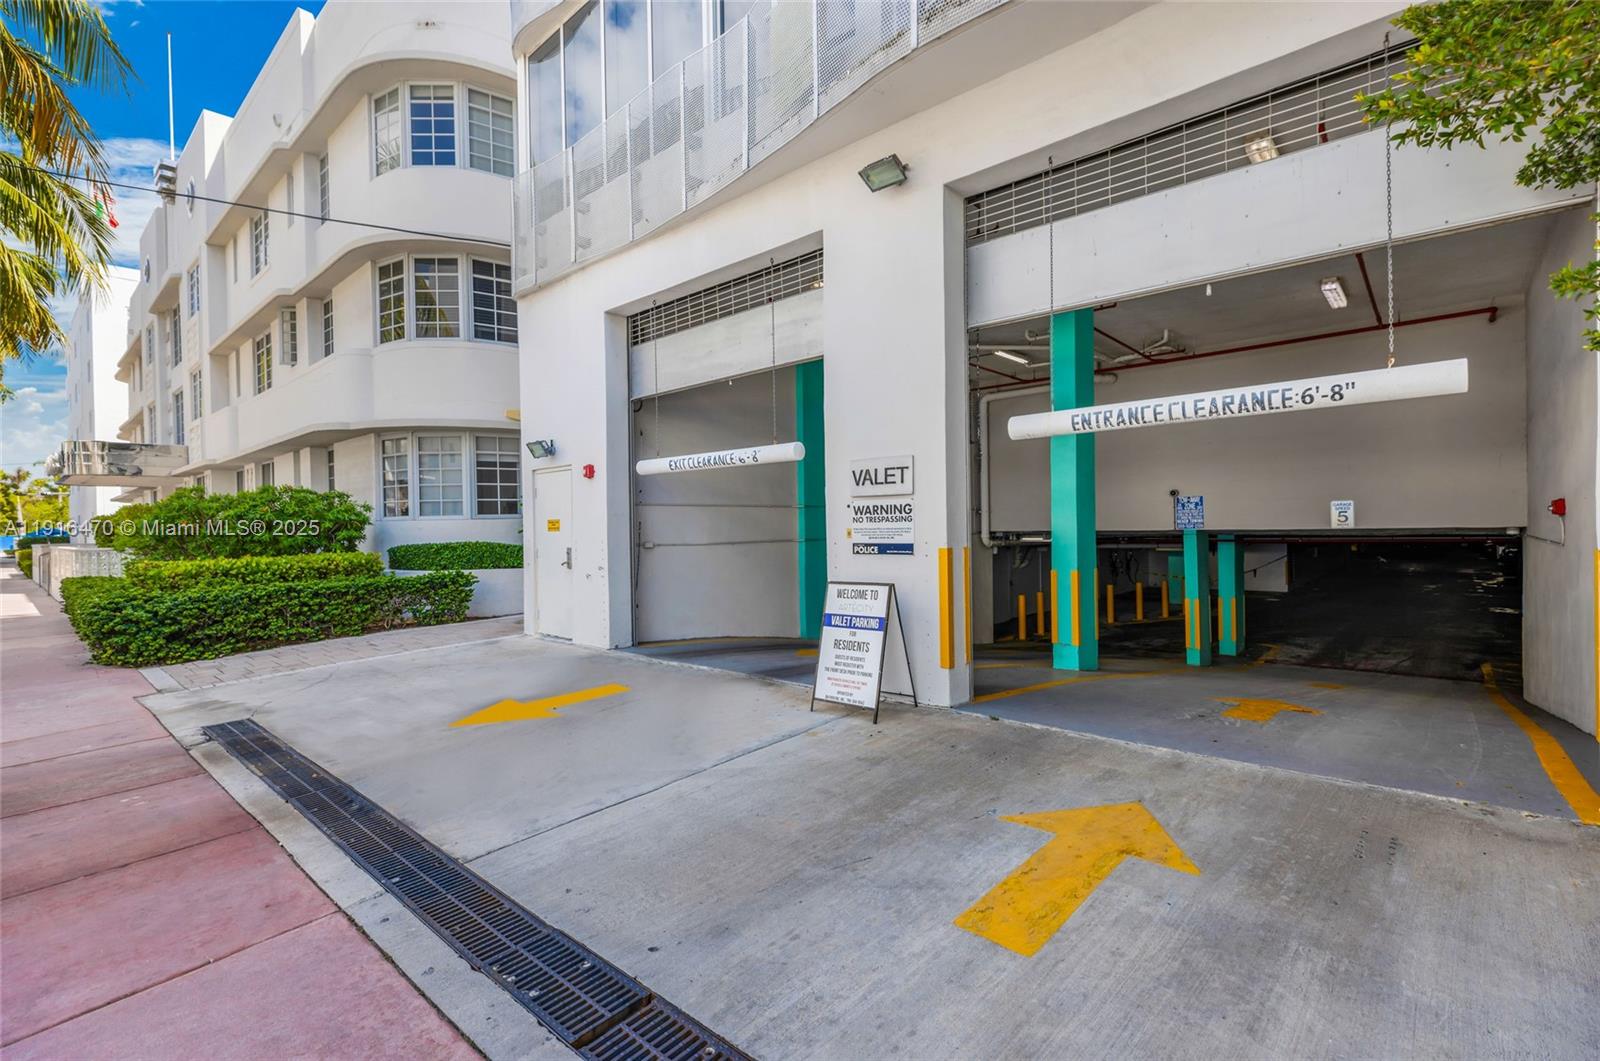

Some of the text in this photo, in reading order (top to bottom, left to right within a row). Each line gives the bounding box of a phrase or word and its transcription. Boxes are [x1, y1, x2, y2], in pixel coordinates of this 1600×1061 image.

[1071, 403, 1166, 432] ENTRANCE
[668, 458, 687, 471] EXIT
[852, 466, 909, 487] VALET
[853, 503, 913, 516] WARNING
[852, 515, 913, 524] NO TRESPASSING
[1337, 510, 1349, 523] 5
[854, 545, 879, 554] POLICE
[836, 588, 879, 600] WELCOME TO
[831, 615, 880, 629] VALET PARKING
[833, 639, 870, 653] RESIDENTS
